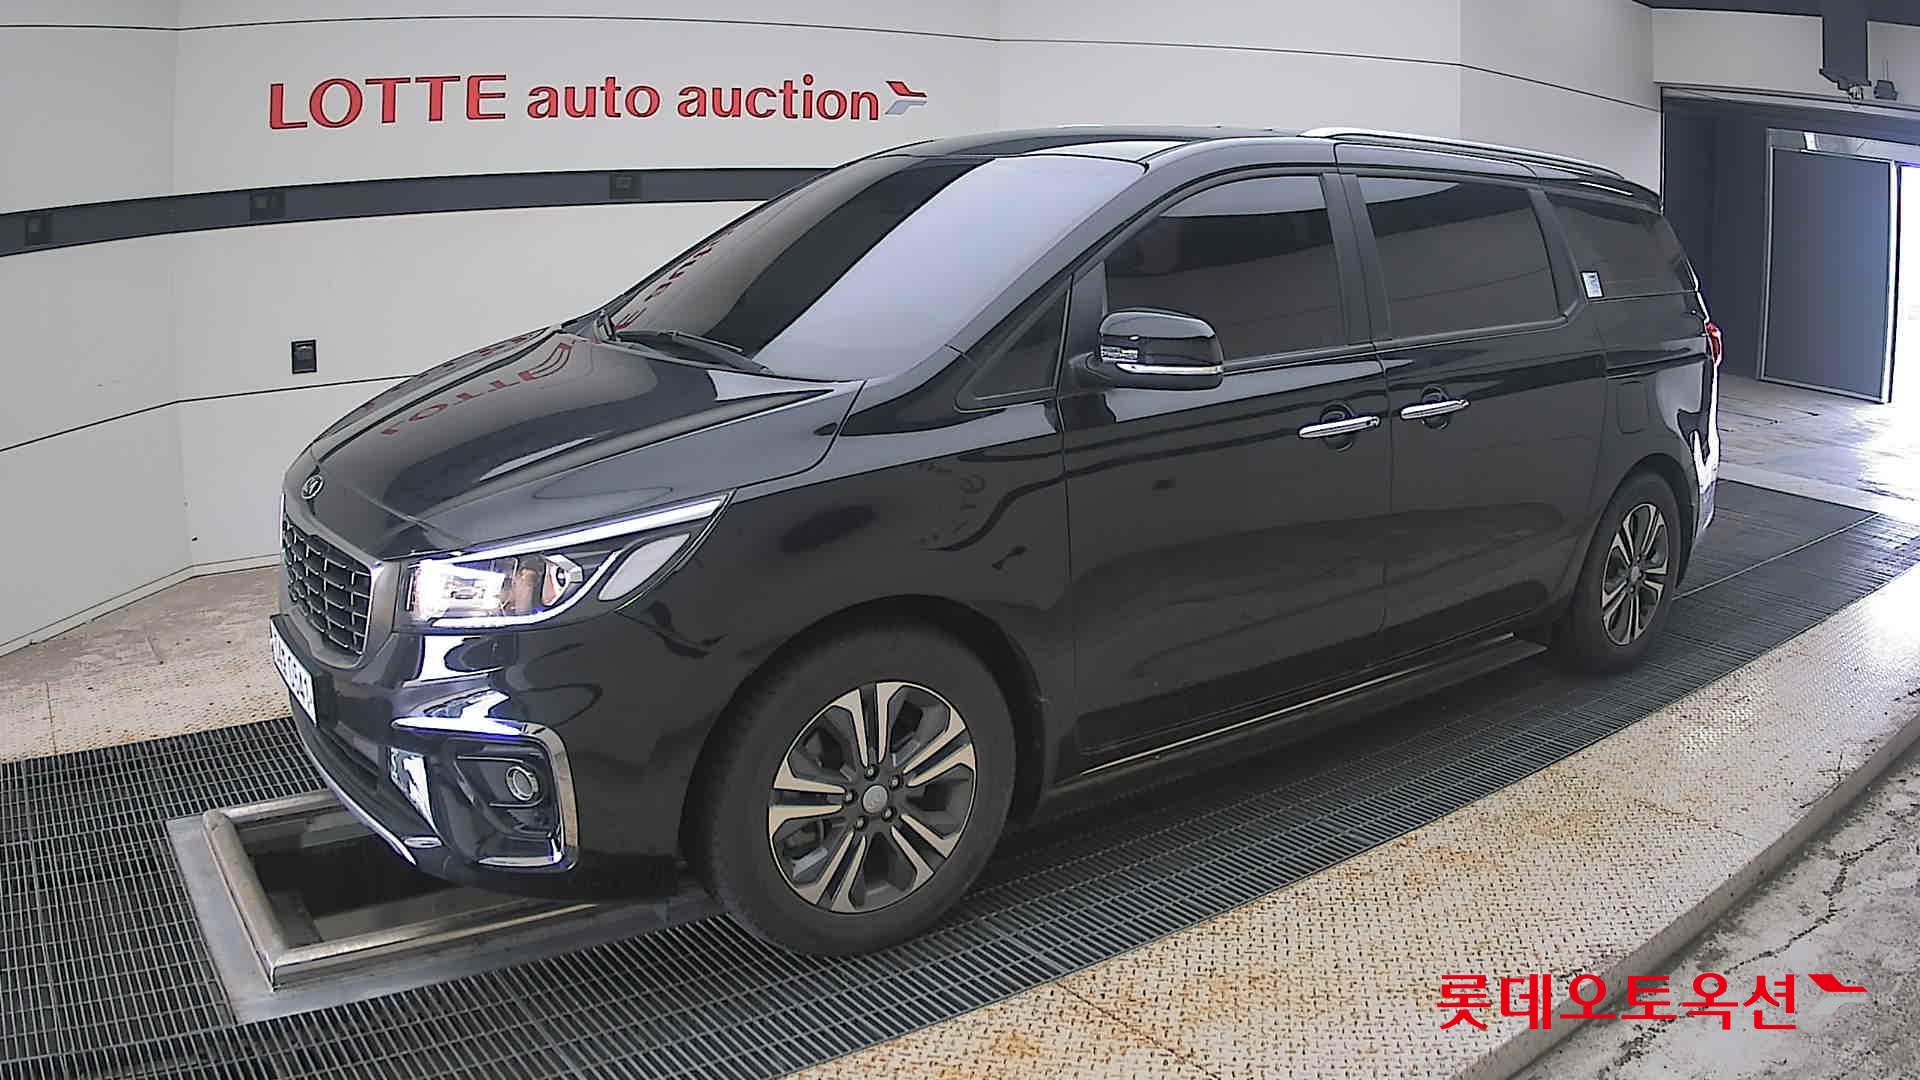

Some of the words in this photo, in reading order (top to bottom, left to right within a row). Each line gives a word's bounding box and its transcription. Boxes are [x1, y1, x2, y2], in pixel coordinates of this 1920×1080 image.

[269, 74, 508, 130] LOTTE
[526, 76, 662, 120] auto
[677, 73, 880, 121] auction
